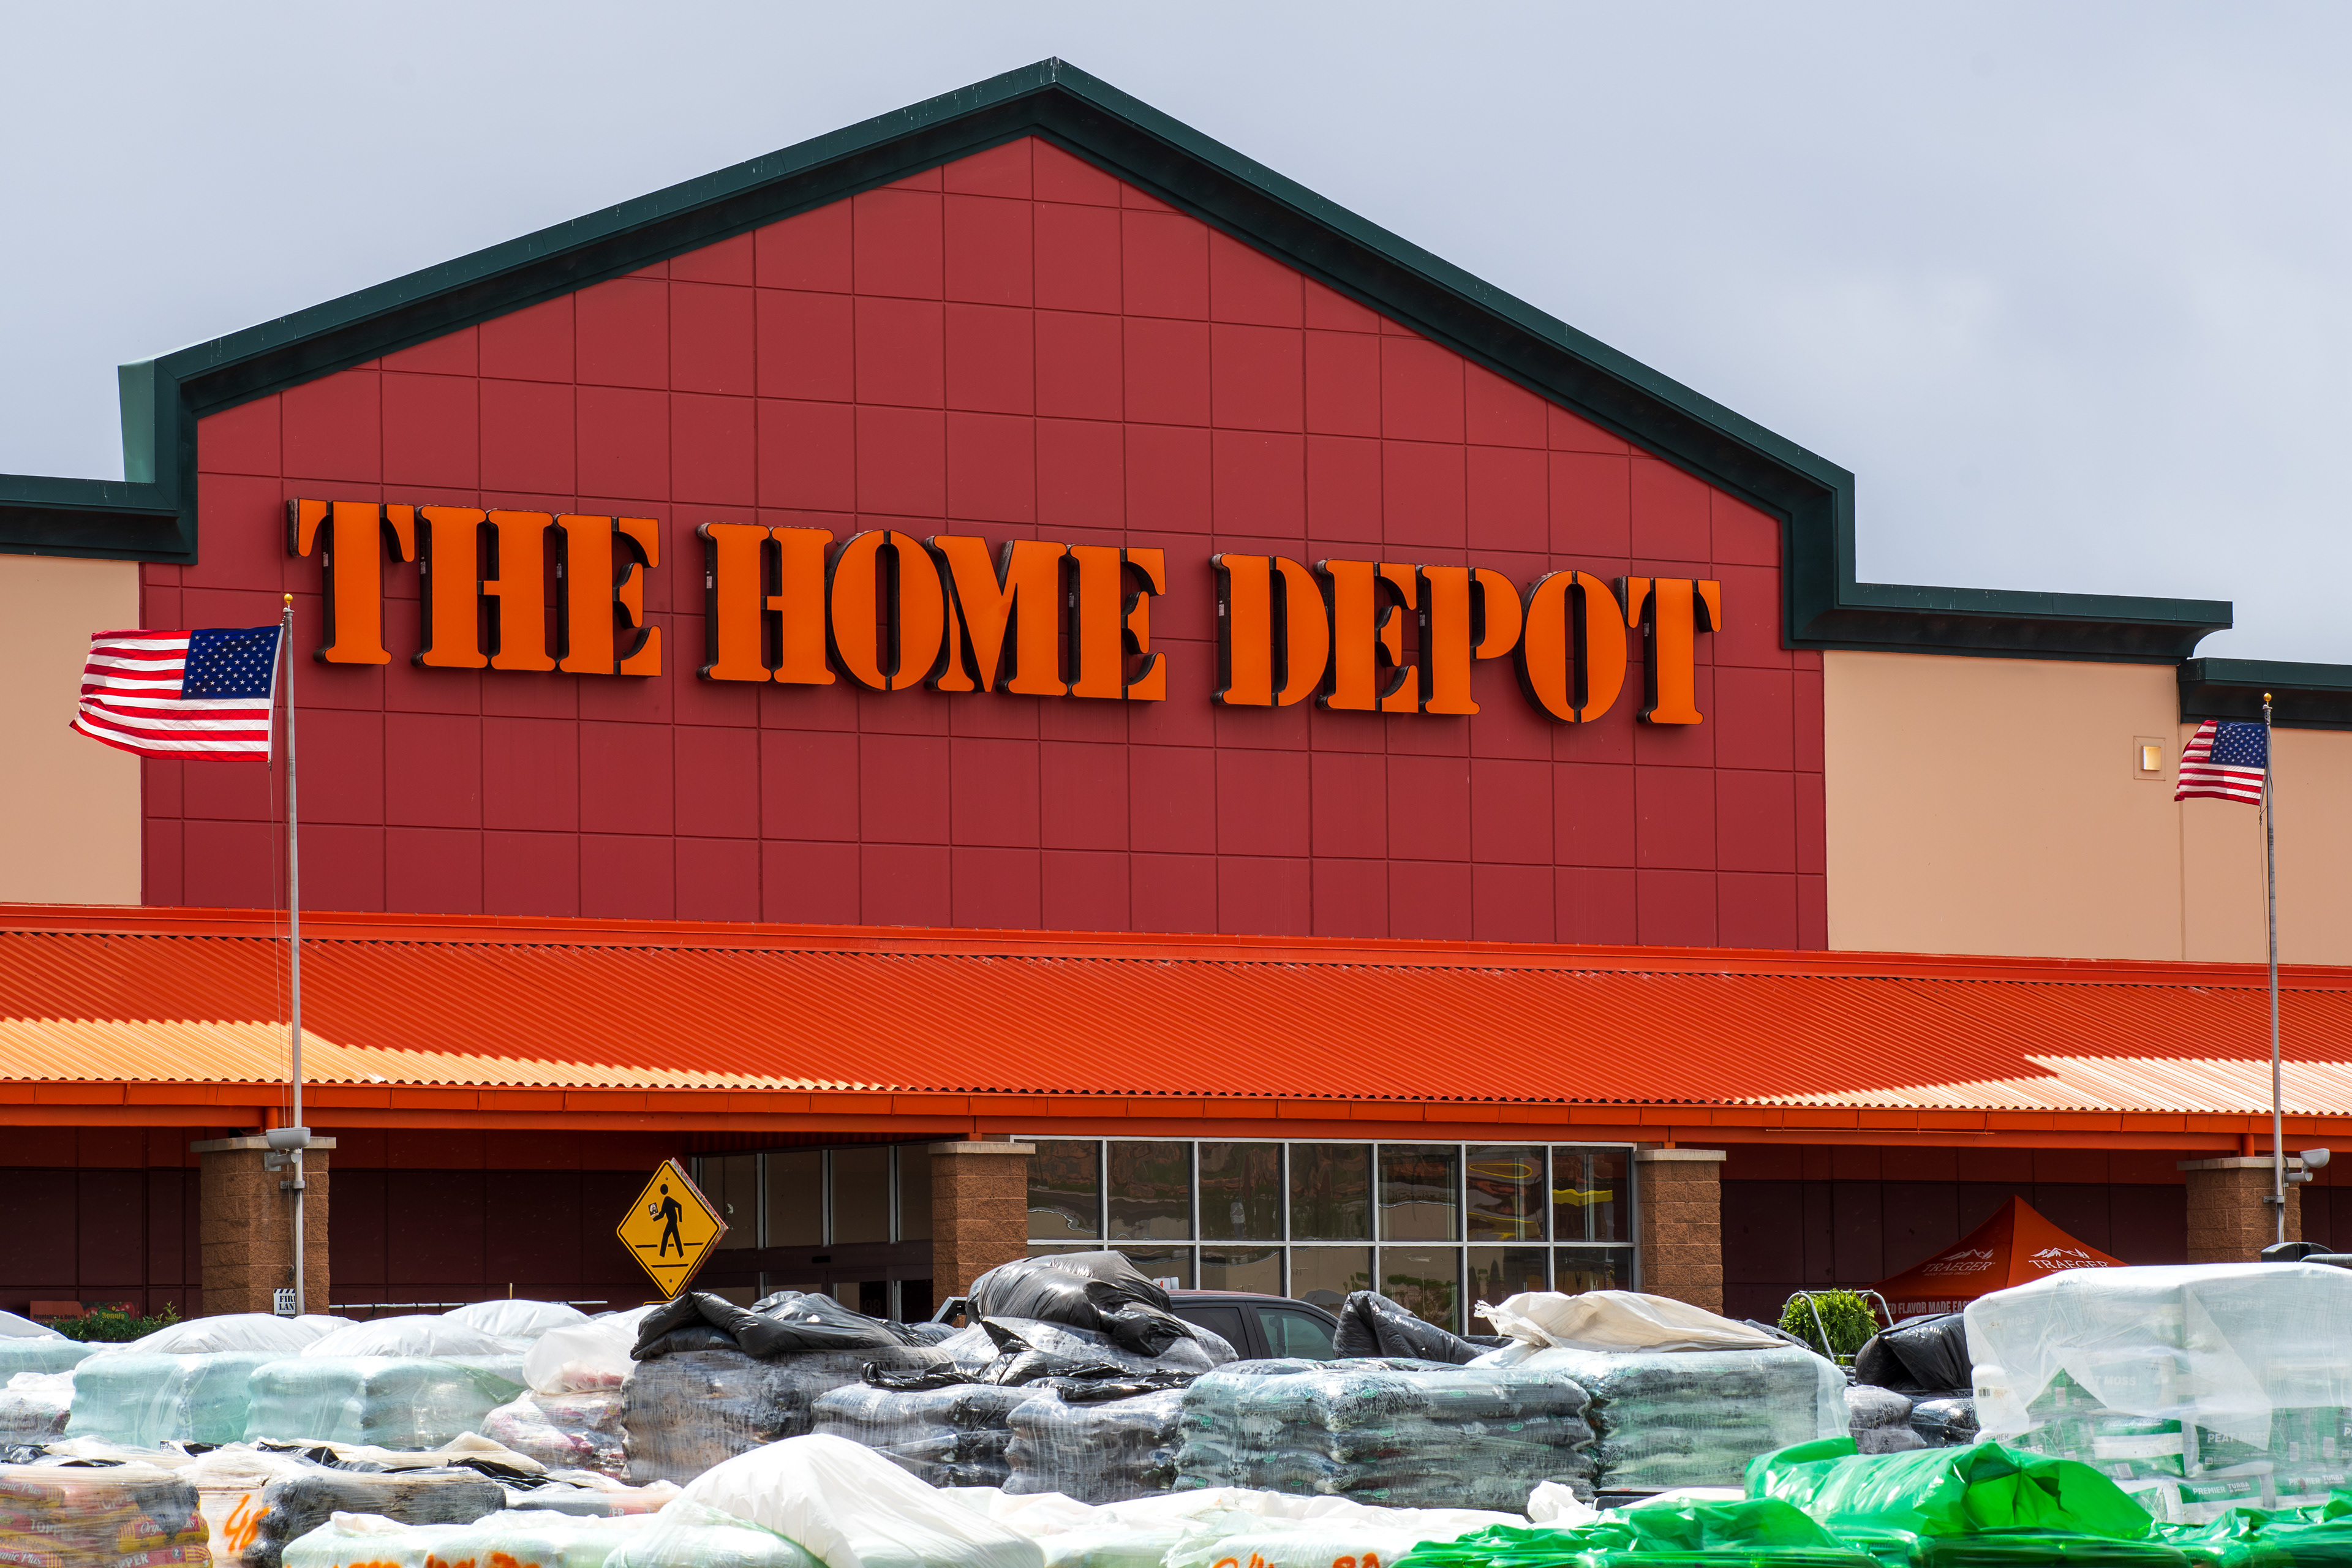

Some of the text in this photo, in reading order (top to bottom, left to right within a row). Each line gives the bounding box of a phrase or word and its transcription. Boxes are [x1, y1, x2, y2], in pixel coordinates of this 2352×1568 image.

[288, 497, 1722, 725] THE HOME DEPOT
[1899, 1302, 1927, 1314] FLAVOR
[1928, 1301, 1951, 1313] MADE
[2207, 1433, 2236, 1442] PEAT
[21, 1482, 41, 1494] Plus
[2193, 1486, 2226, 1494] PREMIER
[21, 1552, 41, 1564] Plus
